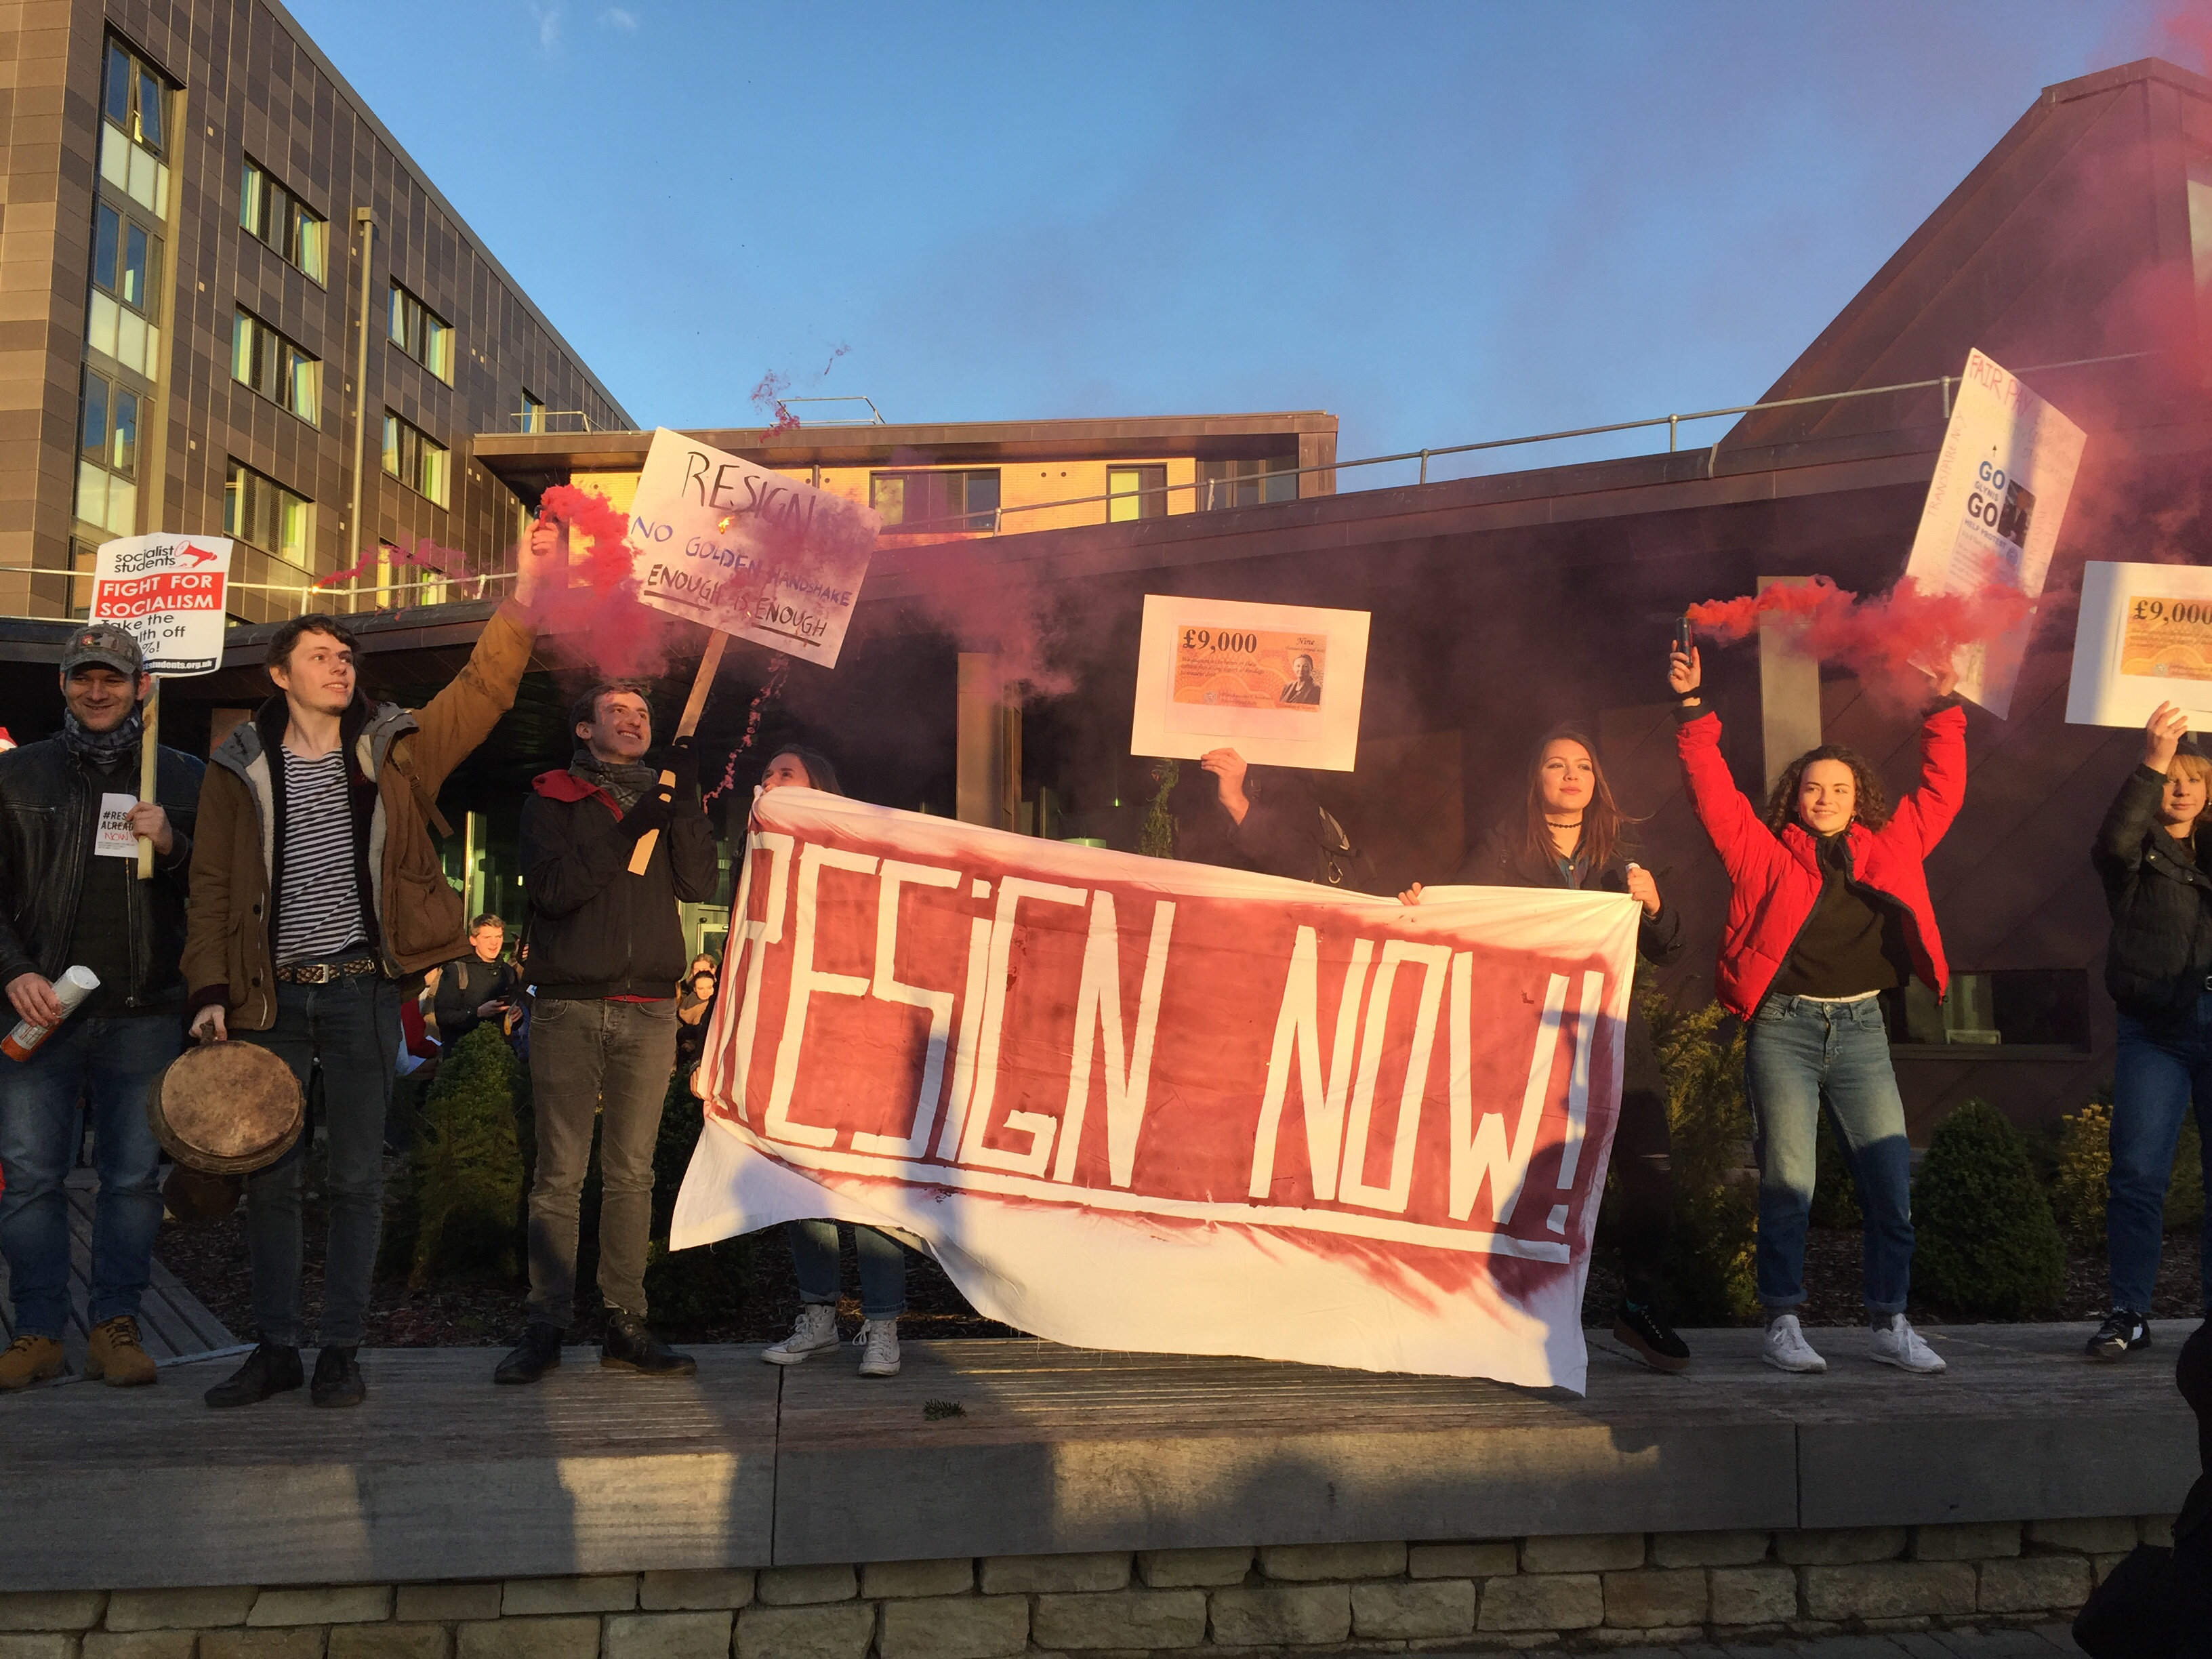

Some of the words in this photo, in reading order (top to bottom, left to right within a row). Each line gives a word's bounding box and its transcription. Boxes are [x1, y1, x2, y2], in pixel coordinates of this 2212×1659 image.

[1969, 354, 2003, 400] FAIR
[2004, 378, 2034, 418] PAY
[1979, 461, 2005, 490] GO
[682, 451, 816, 527] RESIGN
[1974, 480, 1999, 501] GLYNIS
[1967, 492, 1999, 527] GO
[1965, 517, 1980, 531] HELP
[114, 556, 176, 573] students
[115, 545, 175, 563] socialist
[630, 516, 674, 542] NO
[685, 536, 763, 578] GOLDEN
[768, 568, 853, 607] HANDSHAKE
[103, 577, 161, 597] FIGHT
[171, 575, 213, 589] FOR
[100, 594, 214, 617] SOCIALISM
[647, 563, 722, 607] ENOUGH
[755, 597, 827, 637] ENOUGH
[148, 614, 174, 626] the
[2133, 600, 2212, 625] £9,000
[163, 626, 186, 638] off
[1182, 629, 1258, 655] £9,000
[101, 821, 134, 831] ALREAD
[103, 811, 127, 820] #RES
[1249, 926, 1603, 1233] NOW!
